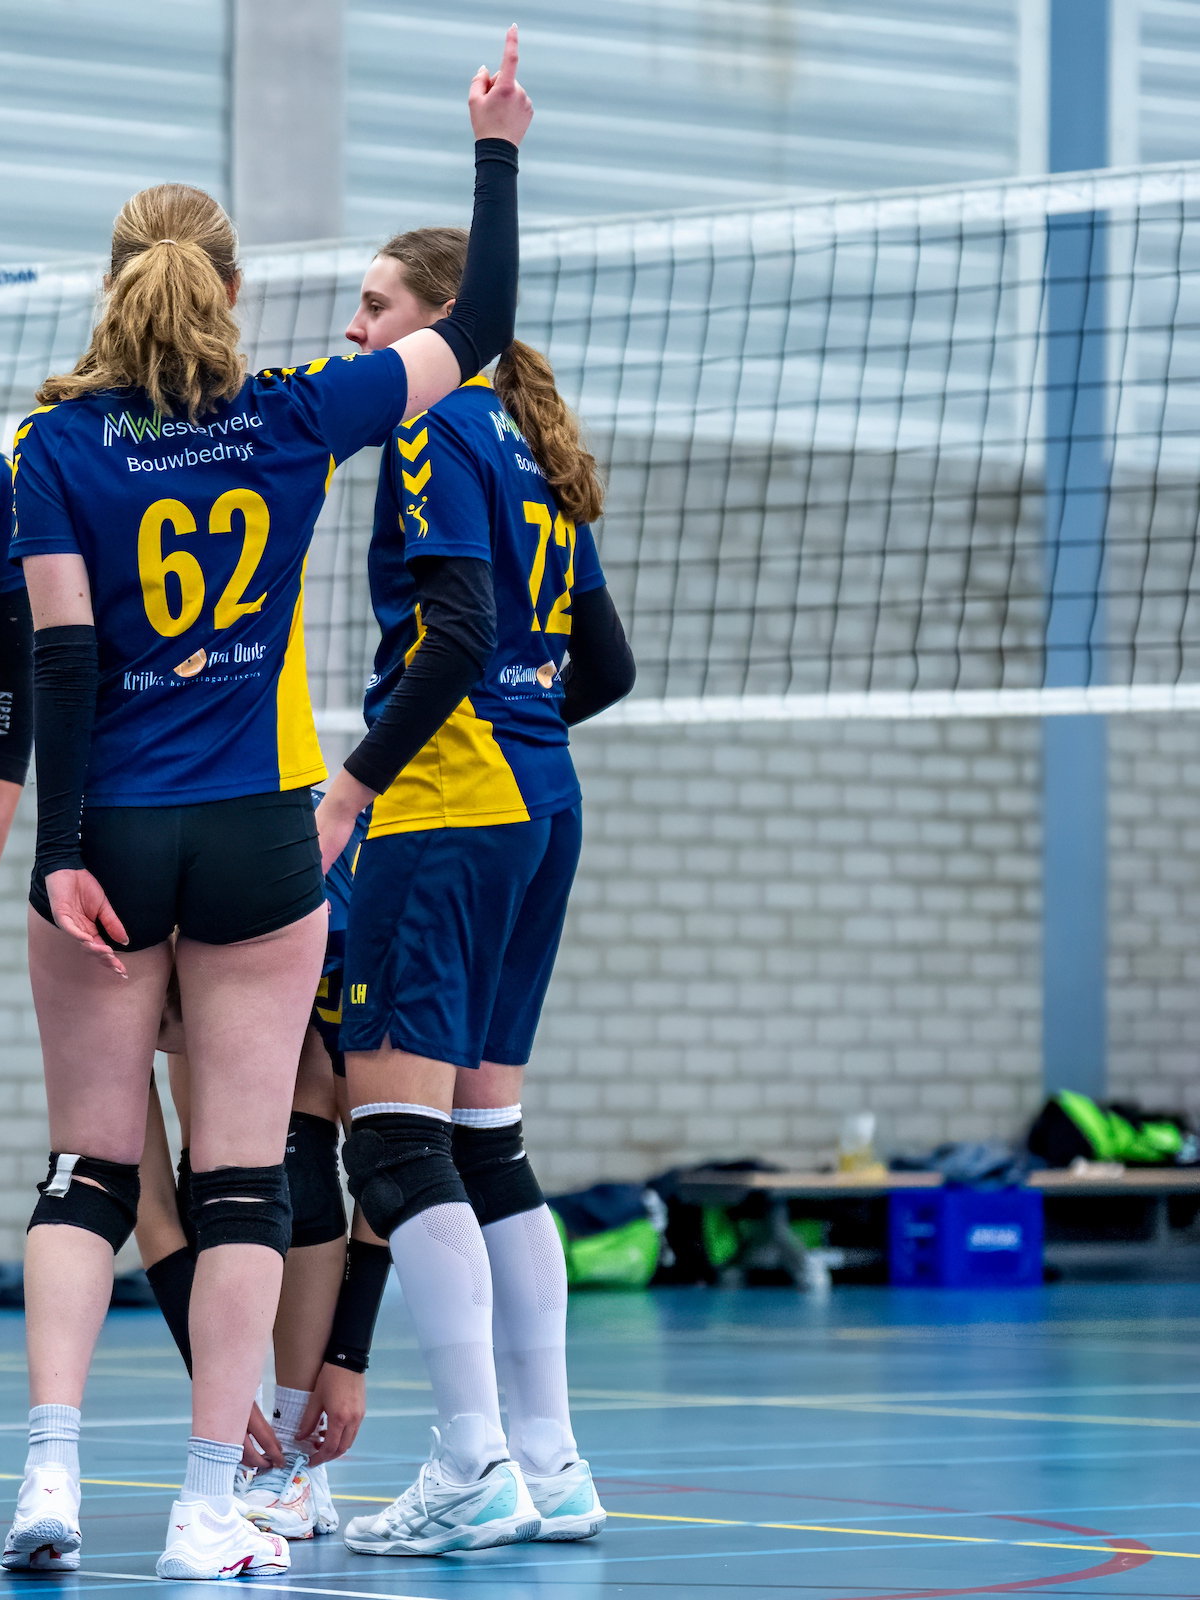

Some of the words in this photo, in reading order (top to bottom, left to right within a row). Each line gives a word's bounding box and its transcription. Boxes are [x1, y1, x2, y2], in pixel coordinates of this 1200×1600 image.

[126, 442, 254, 472] Bouwbedrijf
[138, 488, 270, 638] 62
[351, 984, 368, 1005] LH
